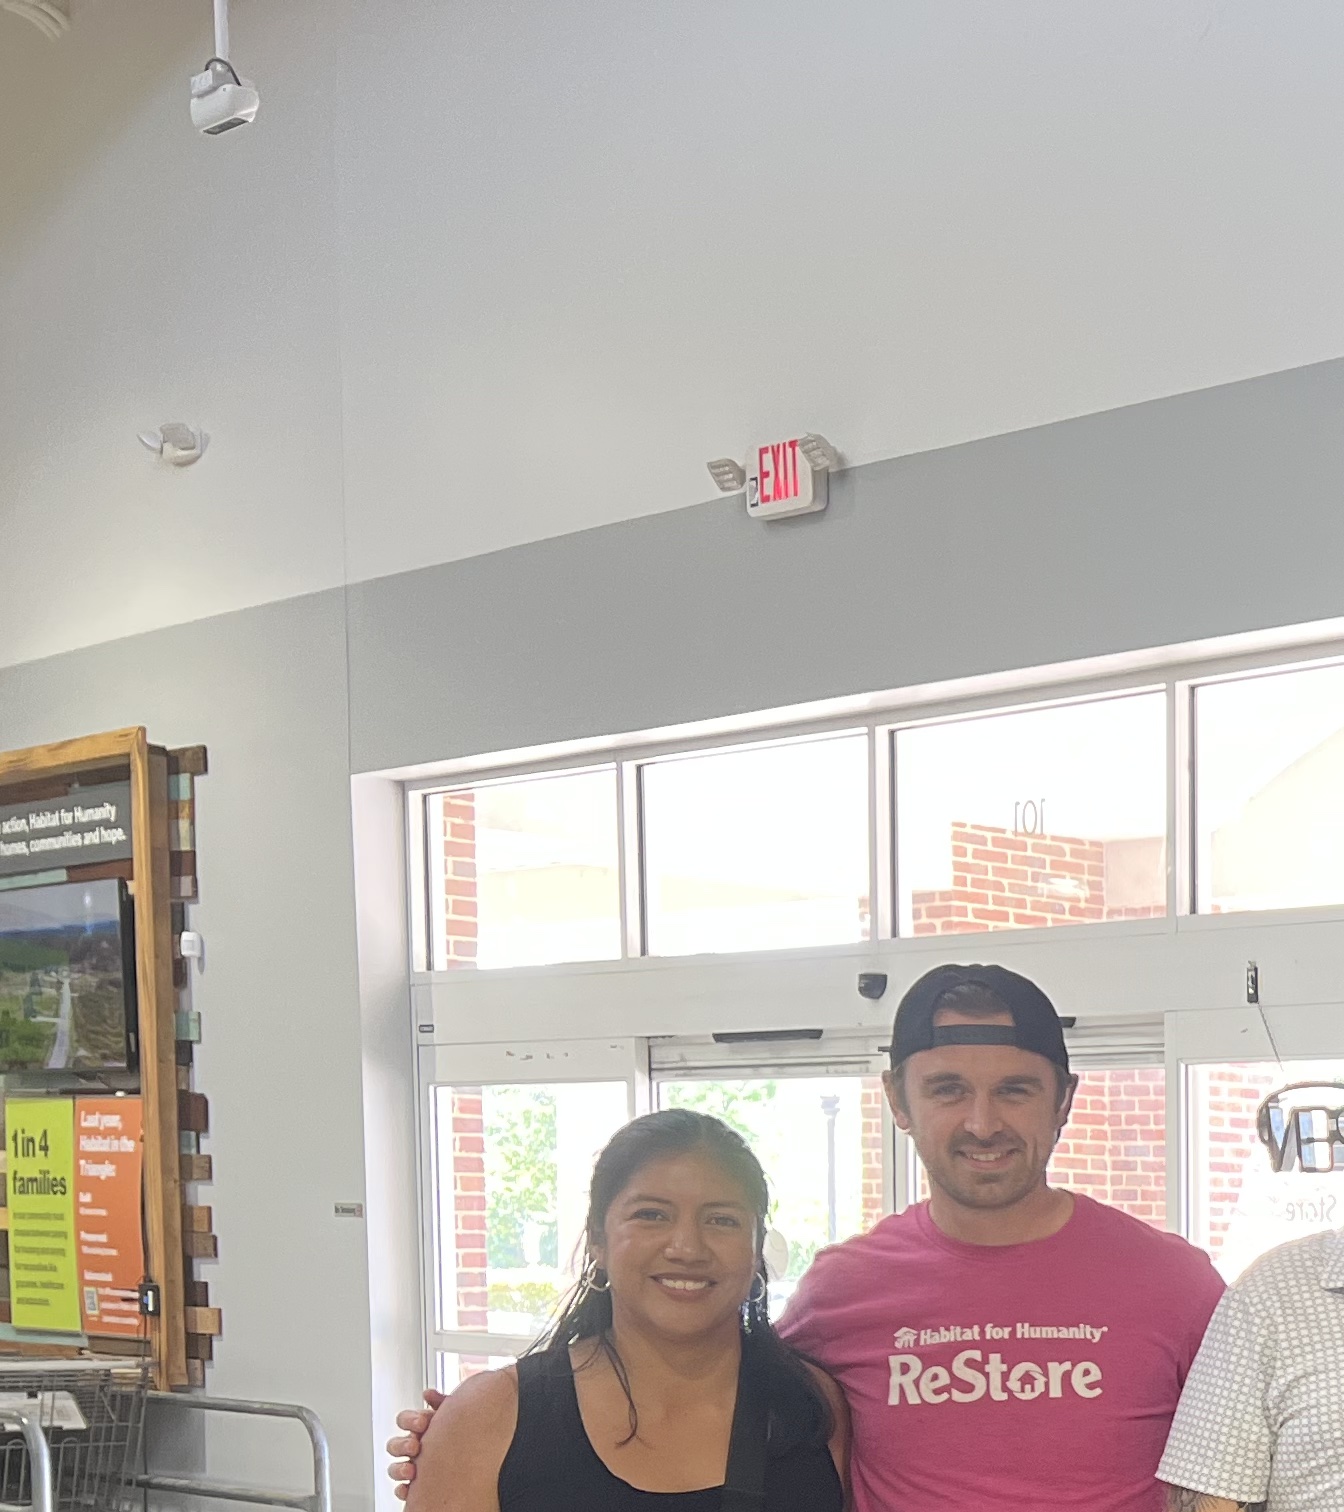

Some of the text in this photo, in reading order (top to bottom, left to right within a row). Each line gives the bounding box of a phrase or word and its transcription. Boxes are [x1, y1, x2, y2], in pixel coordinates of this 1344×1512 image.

[758, 438, 799, 504] EXIT
[29, 810, 60, 830] Habitat
[60, 808, 73, 825] for
[73, 802, 117, 823] Humanity
[29, 831, 82, 852] communities
[83, 826, 100, 845] and
[100, 826, 127, 845] hope.
[12, 1128, 49, 1158] 1 in 4
[12, 1168, 67, 1195] families
[919, 1322, 1106, 1346] Habitat for Humanity
[887, 1349, 1103, 1406] ReStore
